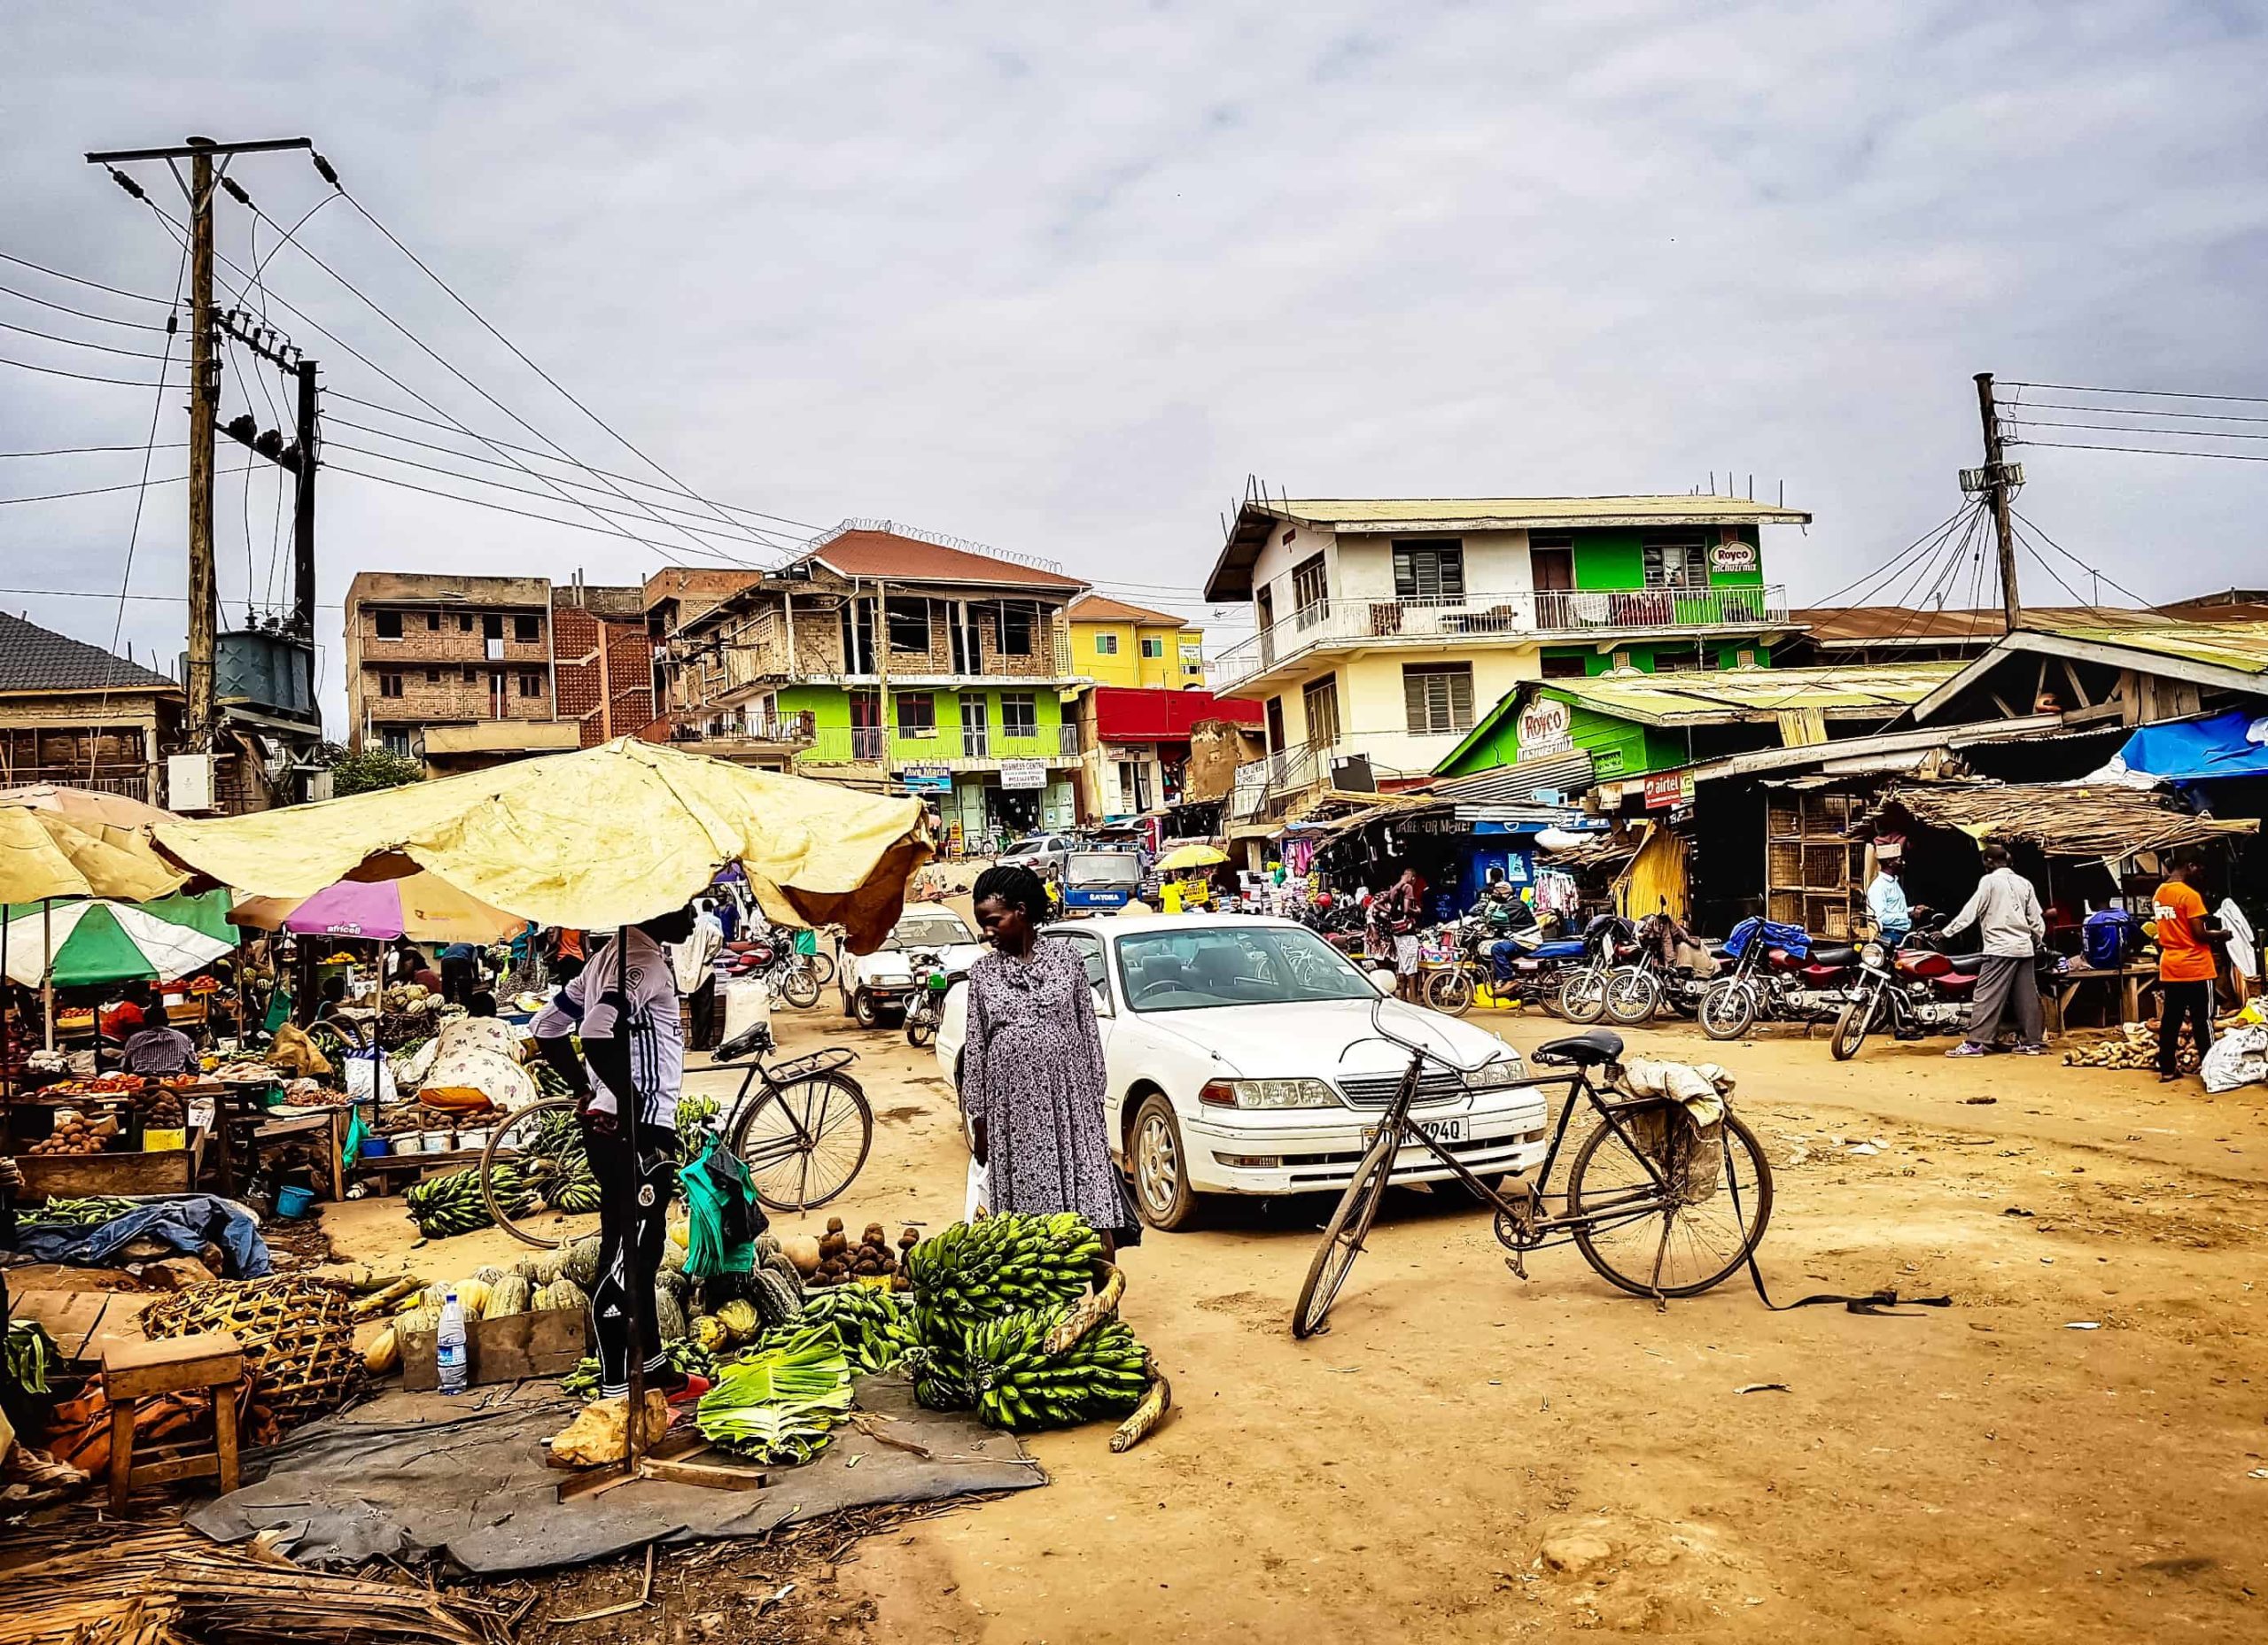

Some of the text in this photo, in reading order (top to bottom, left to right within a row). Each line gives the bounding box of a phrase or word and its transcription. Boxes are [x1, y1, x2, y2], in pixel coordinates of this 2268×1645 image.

[1718, 549, 1748, 562] Royco
[1001, 761, 1045, 771] BUSINESS CENTRE
[906, 767, 948, 777] Ave Maria
[1655, 775, 1679, 794] airtel
